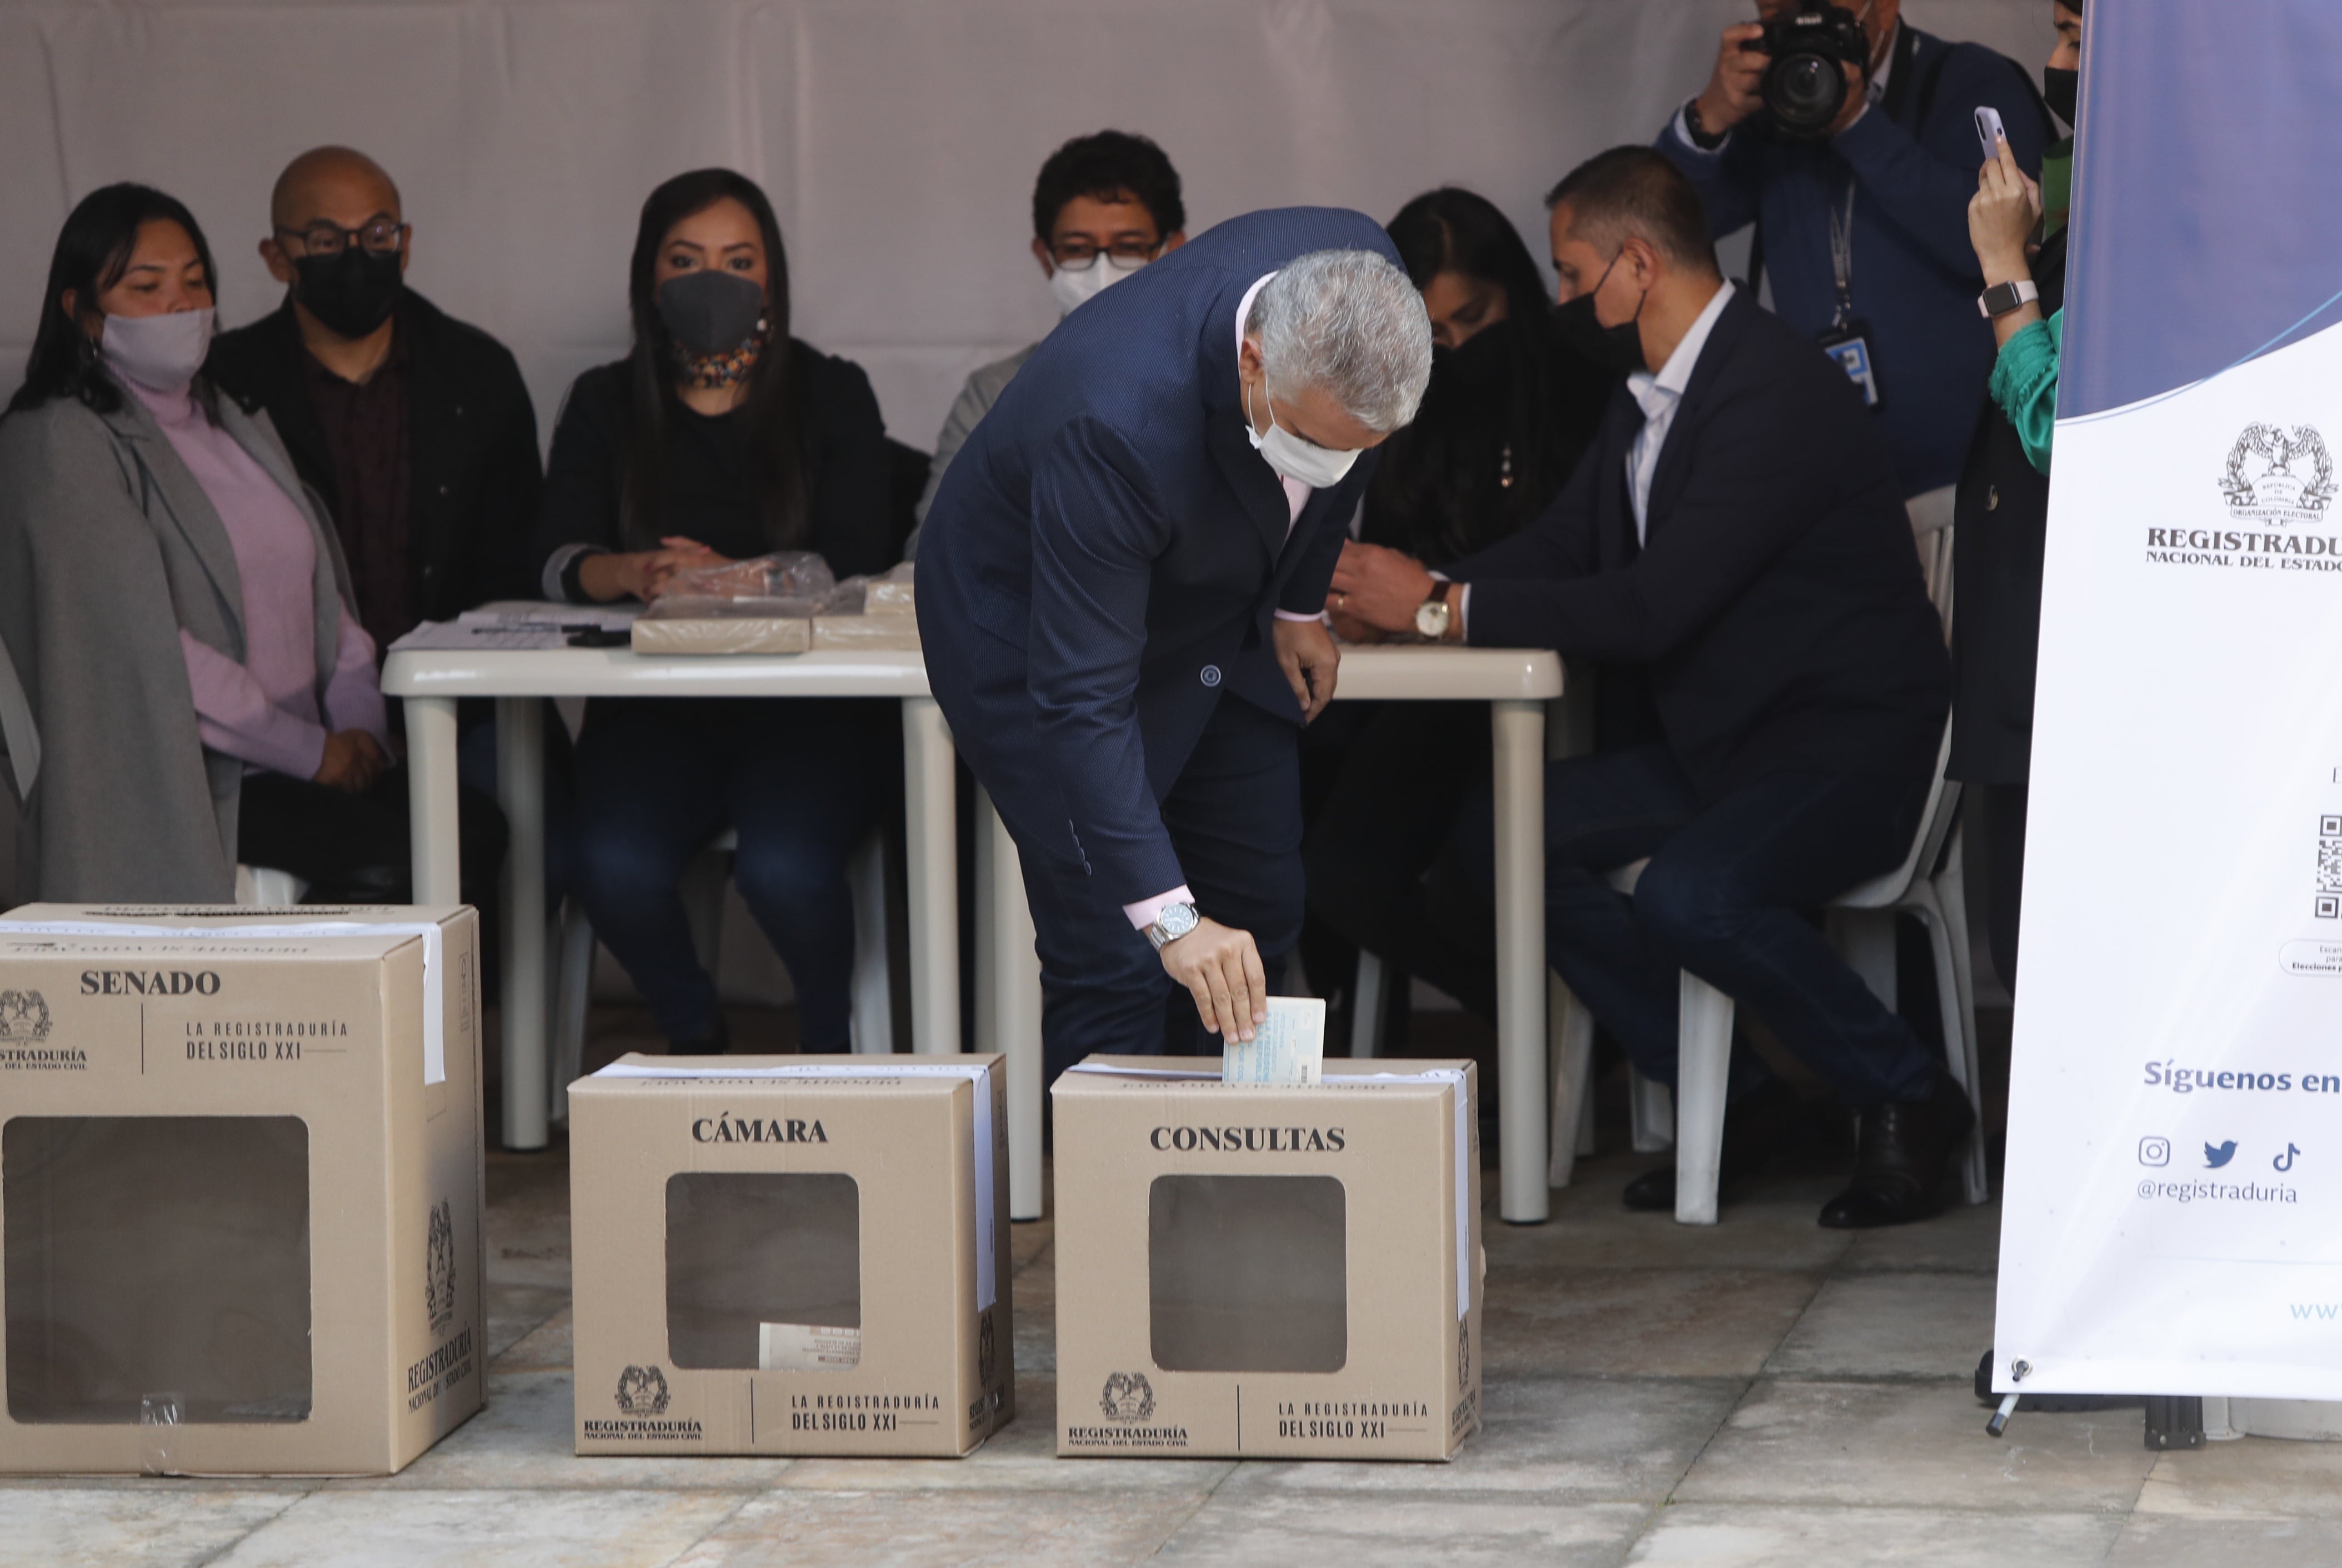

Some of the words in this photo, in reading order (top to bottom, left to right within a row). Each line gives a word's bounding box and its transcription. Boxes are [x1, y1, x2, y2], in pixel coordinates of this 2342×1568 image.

[2233, 507, 2281, 517] ORGANIZACIÓN
[2283, 510, 2321, 520] ELECTORAL
[2146, 551, 2234, 567] NACIONAL
[2240, 556, 2274, 569] DEL
[2293, 961, 2336, 971] Elecciones
[81, 970, 221, 995] SENADO
[186, 1022, 203, 1036] LA
[214, 1020, 347, 1036] REGISTRADURÍA
[187, 1041, 215, 1060] DEL
[219, 1041, 267, 1060] SIGLO
[275, 1041, 300, 1060] XXI
[2144, 1059, 2292, 1093] Síguenos
[2301, 1074, 2340, 1093] en
[692, 1111, 828, 1143] CÁMARA
[1150, 1126, 1345, 1151] CONSULTAS
[2138, 1179, 2297, 1203] @registraduria
[2290, 1303, 2342, 1320] ww
[408, 1321, 472, 1394] REGISTRADURÍA
[408, 1386, 432, 1414] NACIONAL
[446, 1366, 461, 1390] STADO
[792, 1395, 807, 1409] LA
[817, 1392, 939, 1409] REGISTRADURÍA
[1279, 1402, 1294, 1416] LA
[1304, 1400, 1428, 1417] REGISTRADURÍA
[584, 1417, 702, 1431] REGISTRADURÍA
[792, 1413, 819, 1431] DEL
[823, 1413, 866, 1431] SIGLO
[873, 1414, 896, 1431] XXI
[1069, 1424, 1188, 1438] REGISTRADURÍA
[1279, 1420, 1305, 1437] DEL
[1309, 1421, 1353, 1437] SIGLO
[1361, 1421, 1384, 1438] XXI
